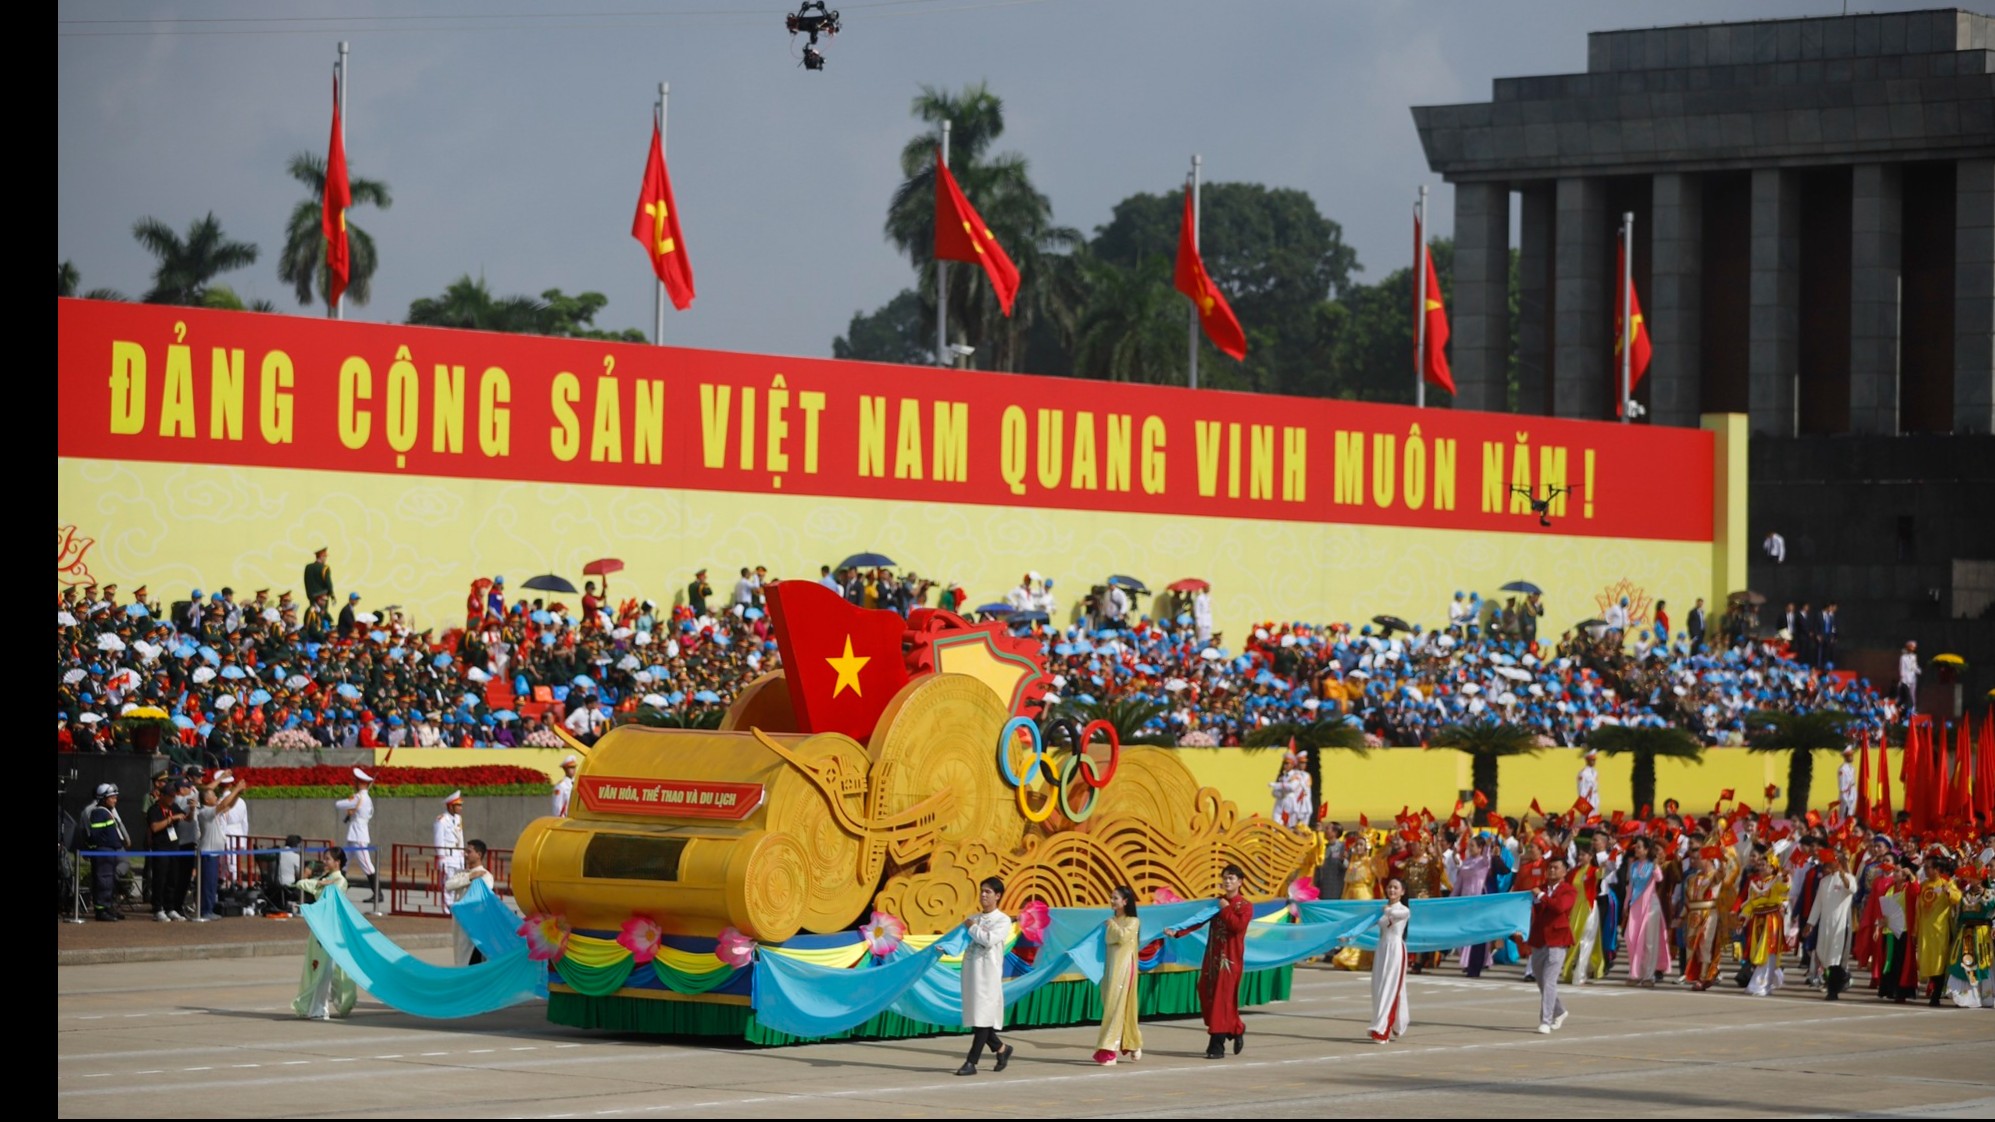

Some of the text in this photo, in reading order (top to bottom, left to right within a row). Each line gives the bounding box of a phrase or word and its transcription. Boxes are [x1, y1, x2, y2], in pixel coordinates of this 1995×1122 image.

[109, 321, 295, 445] ĐẢNG
[338, 345, 511, 468] CỘNG
[551, 354, 665, 465] SẢN
[699, 373, 826, 488] VIỆT
[858, 395, 969, 483] NAM
[1000, 404, 1167, 496] QUANG
[1194, 420, 1307, 502] VINH
[1333, 422, 1457, 511] MUÔN
[1481, 431, 1567, 517] NĂM
[598, 784, 737, 808] VĂN HÓA, THỂ THAO VÀ DU LỊCH
